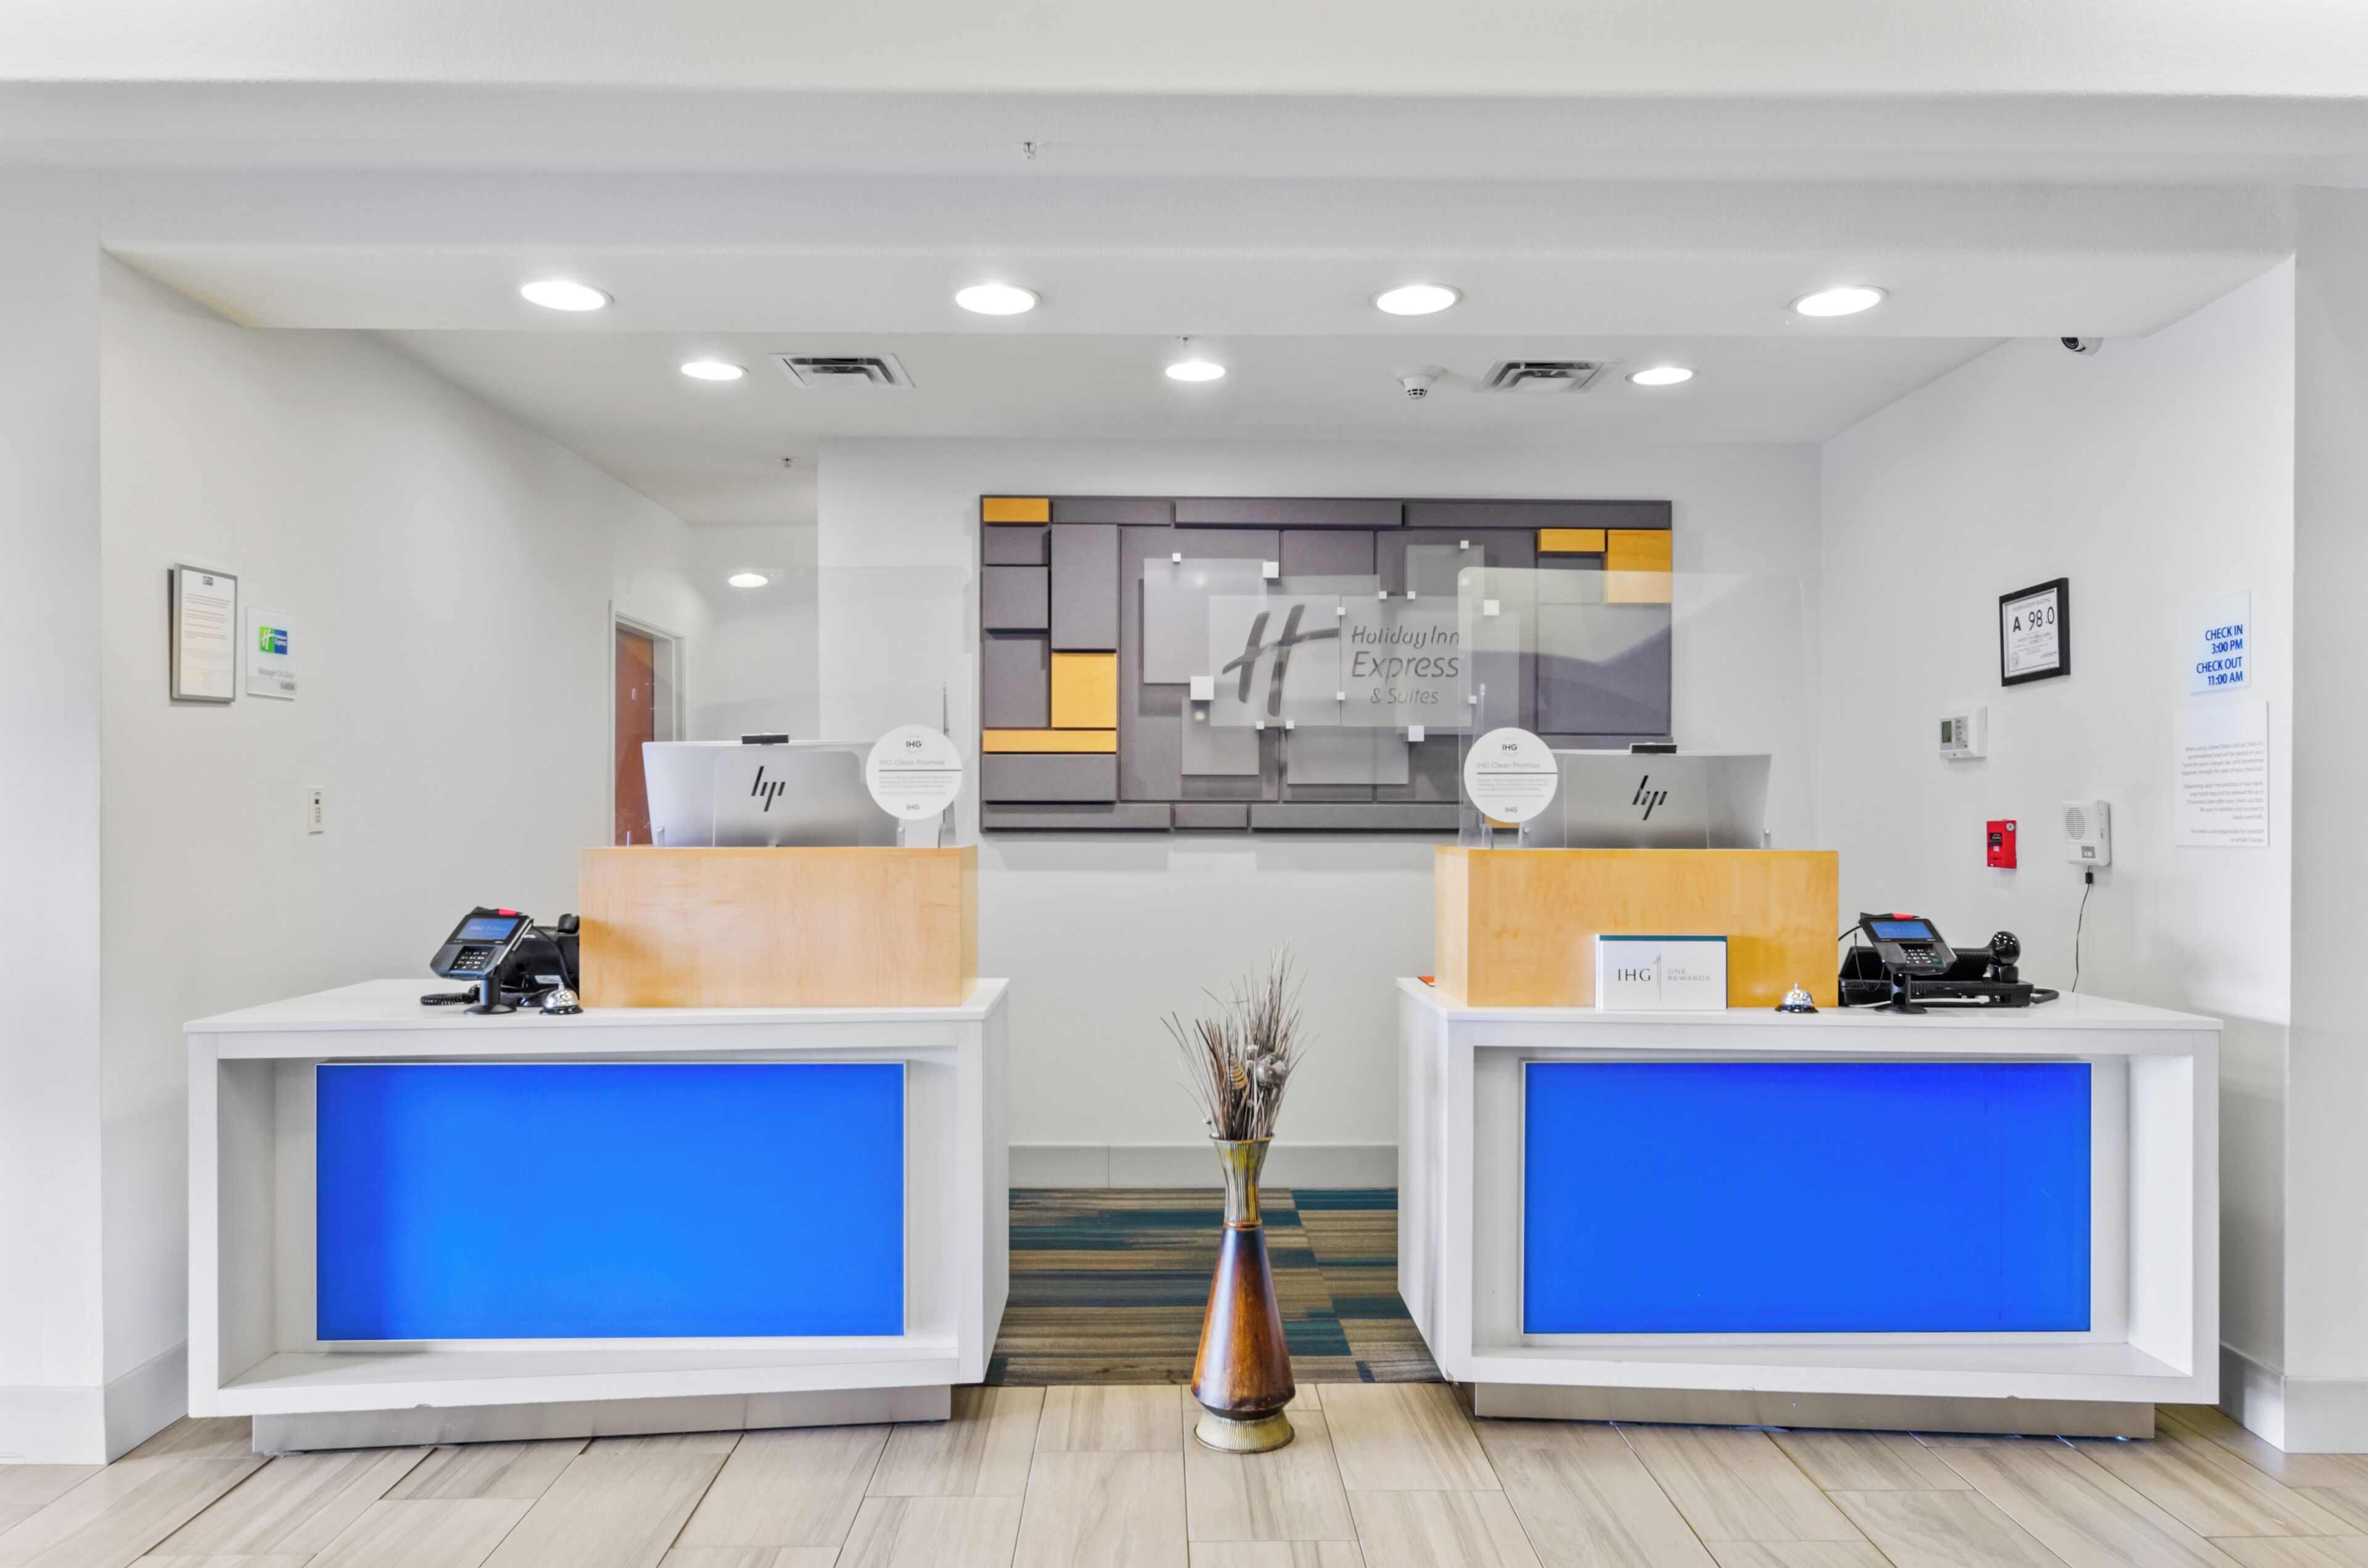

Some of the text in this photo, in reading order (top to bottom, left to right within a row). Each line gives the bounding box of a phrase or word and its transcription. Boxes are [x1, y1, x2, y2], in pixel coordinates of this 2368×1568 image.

[2013, 606, 2055, 633] A 98.0
[1351, 625, 1460, 649] Holiday Inn
[2205, 624, 2243, 641] CHECK IN
[2211, 639, 2243, 654] 3:00 PM
[1352, 651, 1460, 685] Express
[2197, 656, 2243, 674] CHECK OUT
[2208, 671, 2243, 686] 11:00 AM
[1370, 687, 1439, 704] & Suites
[751, 766, 786, 812] hp
[1632, 775, 1667, 821] hp
[1618, 968, 1651, 982] IHG
